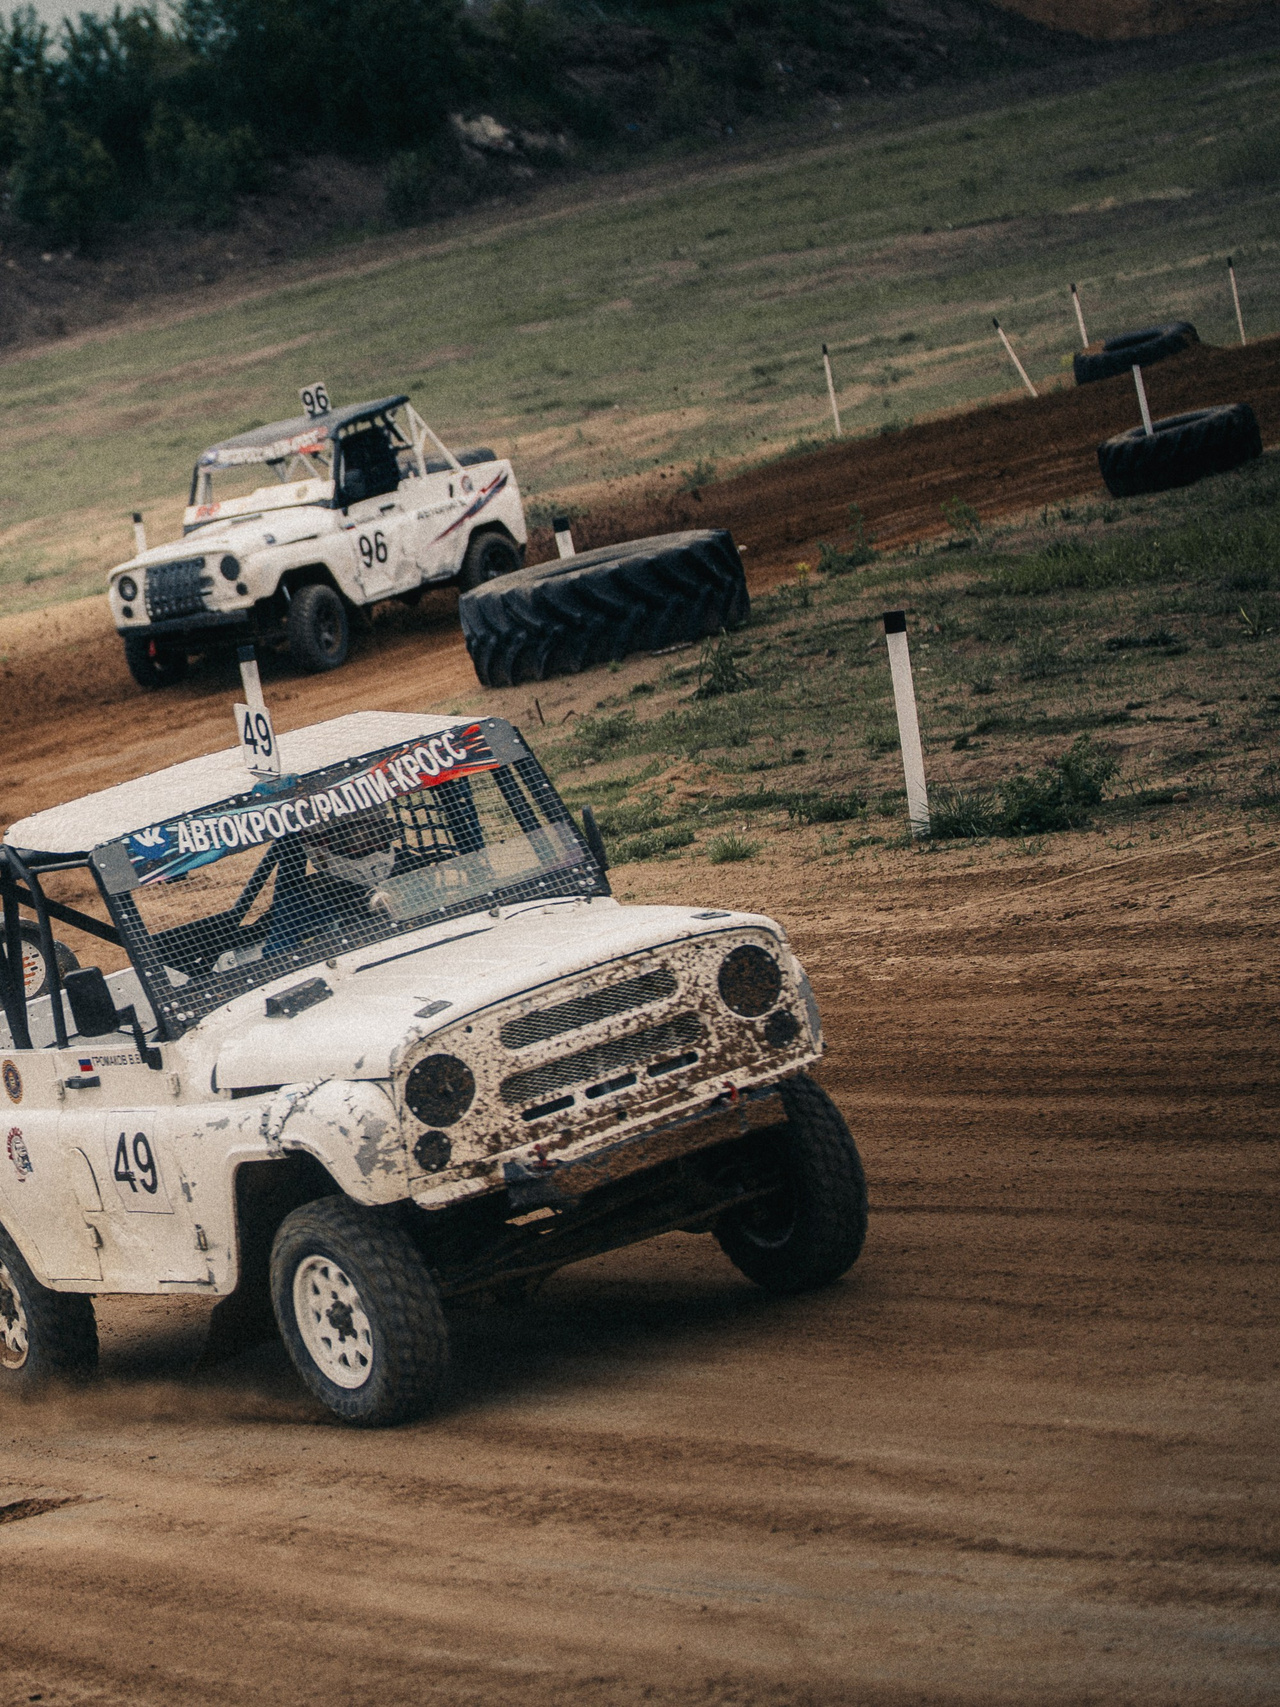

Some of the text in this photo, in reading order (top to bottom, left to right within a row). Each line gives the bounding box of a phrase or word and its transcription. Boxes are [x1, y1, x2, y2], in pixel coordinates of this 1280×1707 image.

[303, 386, 328, 414] 96
[359, 530, 388, 568] 96
[244, 711, 274, 757] 49
[114, 1132, 159, 1195] 49
